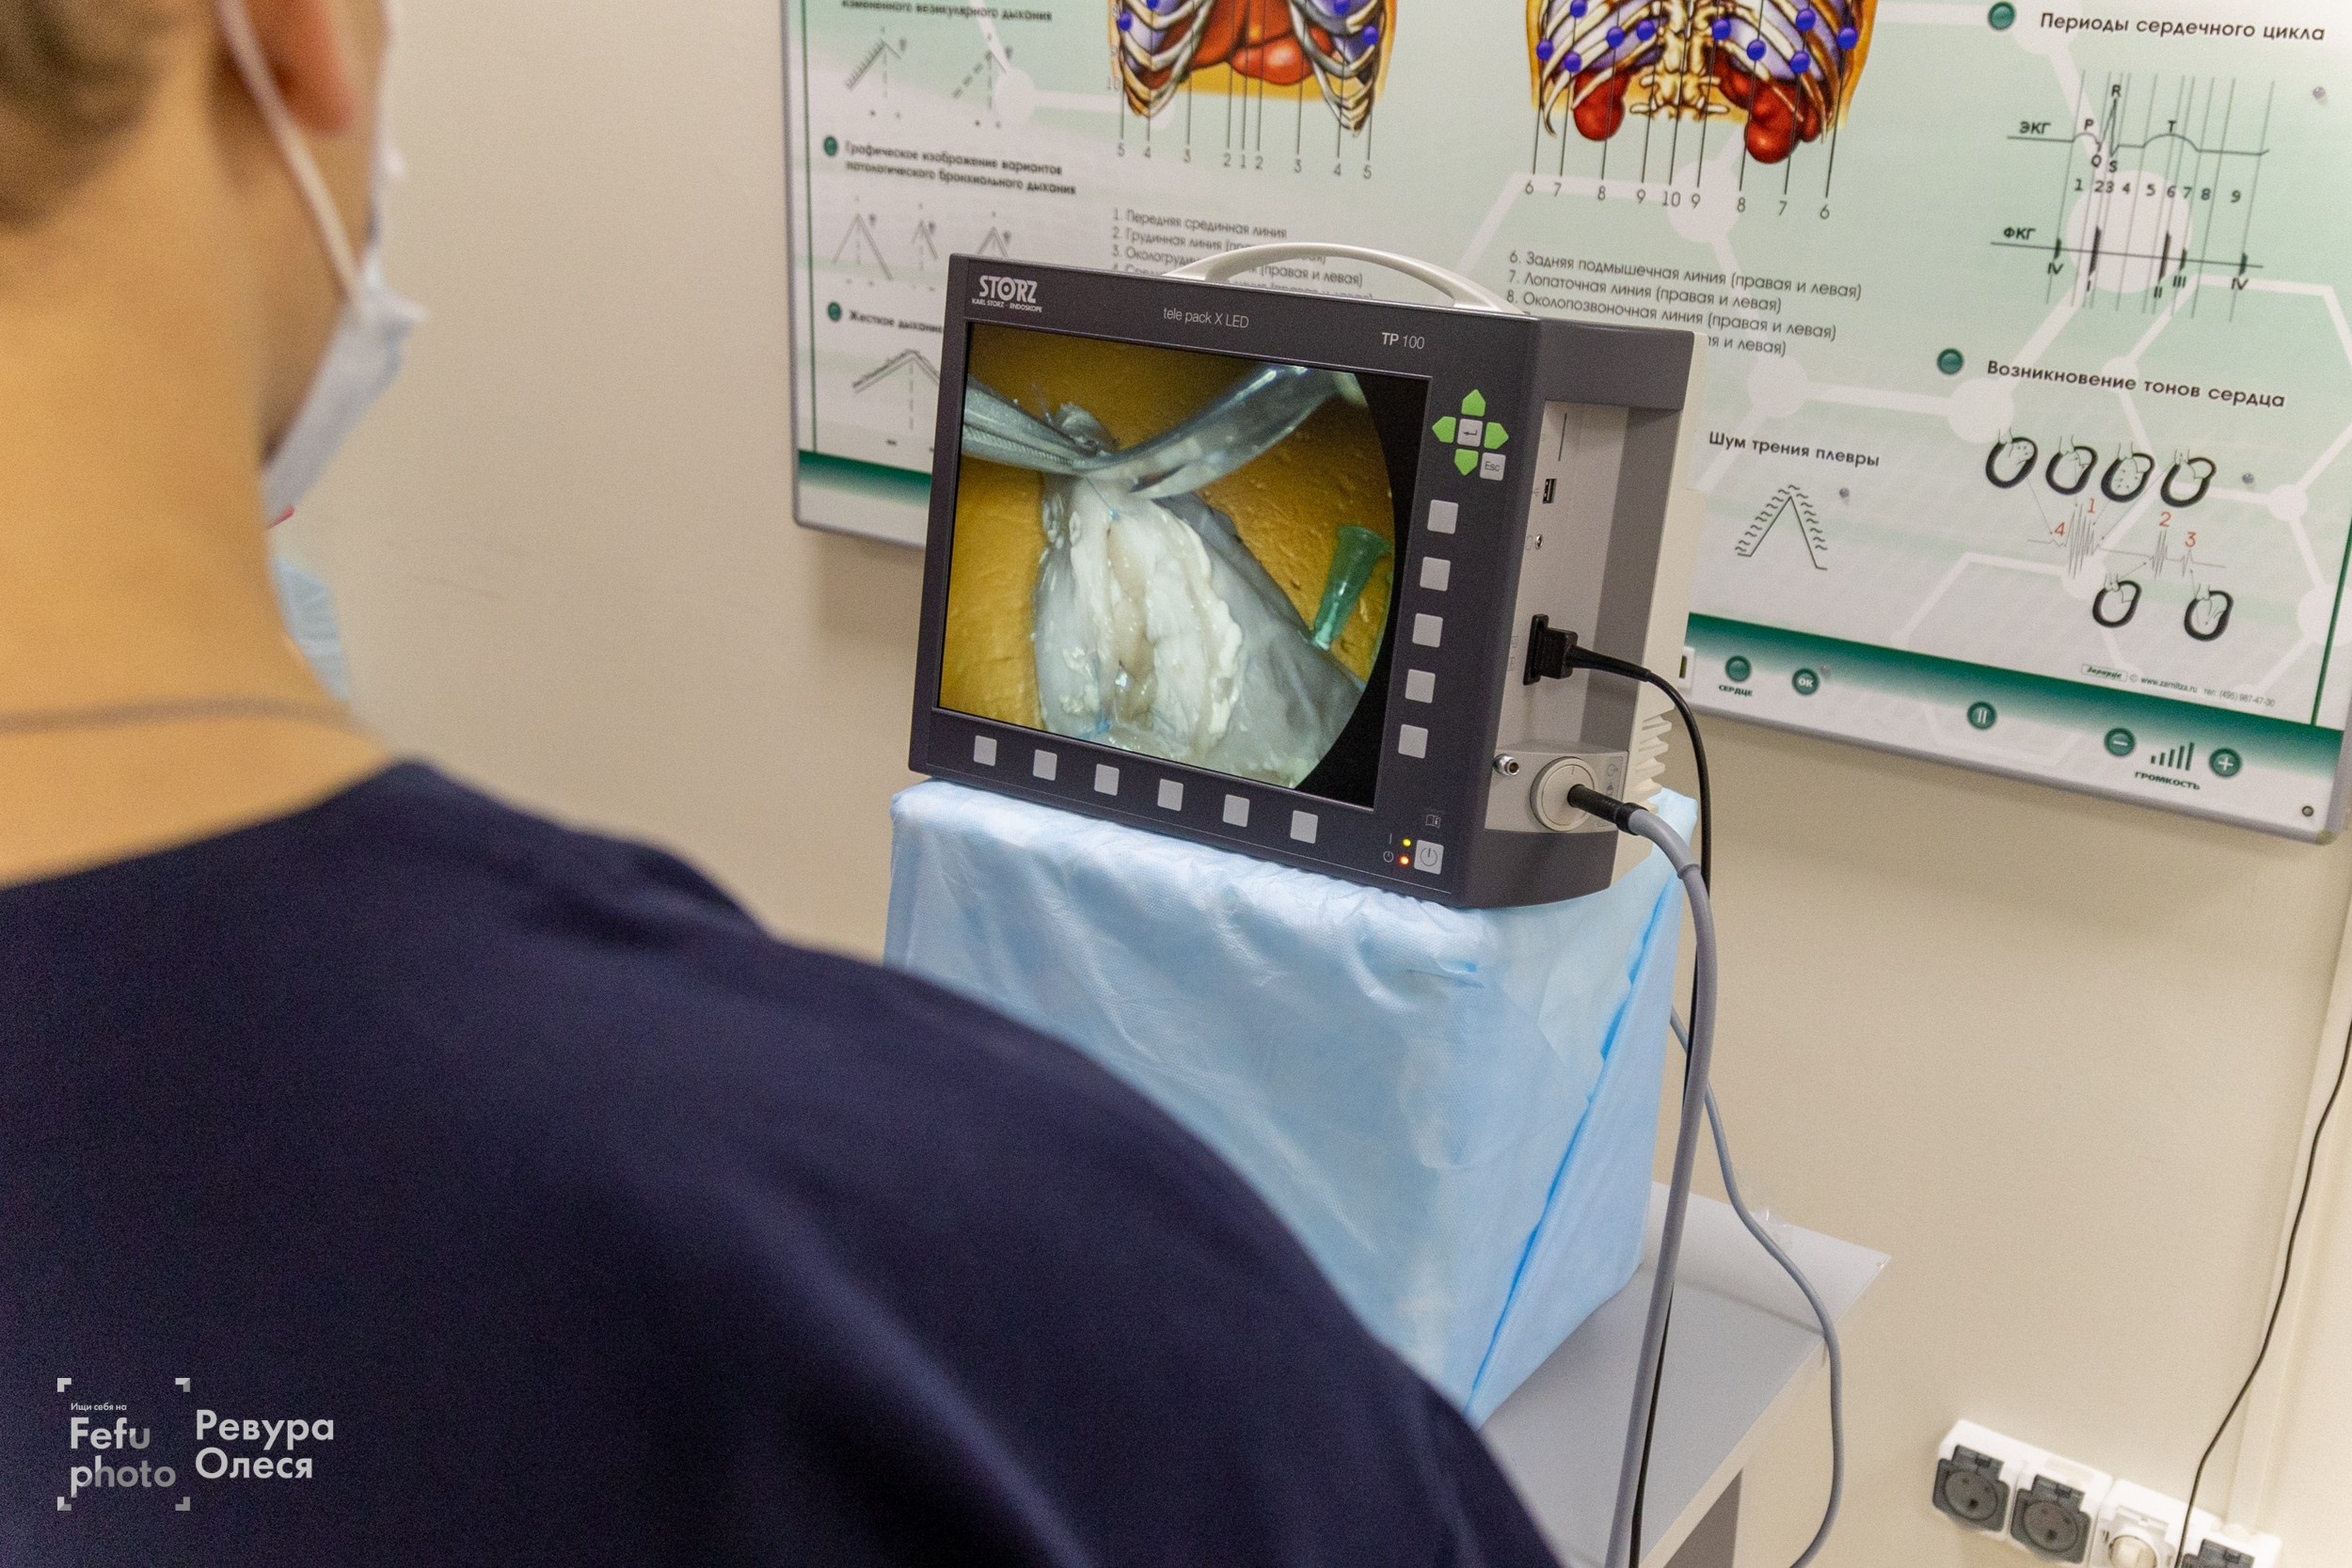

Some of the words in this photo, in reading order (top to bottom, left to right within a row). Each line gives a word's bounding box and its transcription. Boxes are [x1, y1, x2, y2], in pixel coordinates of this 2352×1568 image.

[2041, 12, 2129, 33] Периоды
[2136, 18, 2256, 38] сердечного
[2263, 24, 2325, 40] цикла
[2111, 85, 2122, 98] R
[2019, 120, 2051, 135] ЭКГ
[2084, 119, 2094, 132] P
[2168, 119, 2176, 135] T
[922, 150, 998, 169] изображение
[1223, 152, 1232, 167] 2
[1240, 154, 1248, 169] 1
[1255, 155, 1263, 170] 2
[1294, 159, 1303, 173] 3
[1332, 163, 1343, 177] 4
[1363, 165, 1373, 180] 5
[2108, 160, 2118, 173] S
[2074, 179, 2083, 193] 1
[2094, 181, 2104, 194] 2
[2106, 182, 2115, 195] 3
[2122, 182, 2132, 196] 4
[2146, 184, 2156, 198] 5
[2167, 186, 2176, 199] 6
[2183, 186, 2193, 200] 7
[2200, 188, 2211, 201] 8
[2231, 190, 2242, 204] 9
[1525, 182, 1534, 195] 6
[1553, 182, 1563, 197] 7
[1597, 185, 1606, 200] 8
[1636, 189, 1646, 204] 9
[1662, 191, 1681, 207] 10
[1691, 193, 1701, 209] 9
[1737, 197, 1746, 213] 8
[1779, 200, 1788, 216] 7
[1820, 204, 1831, 220] 6
[1127, 208, 1183, 229] Передняя
[1185, 217, 1250, 235] срединная
[1252, 225, 1288, 239] линия
[1126, 227, 1187, 246] Грудинная
[1189, 237, 1222, 251] линия
[2003, 227, 2036, 241] ФКГ
[1509, 250, 1521, 264] 6.
[1526, 251, 1575, 270] Задняя
[1579, 258, 1679, 280] подмышечная
[1683, 269, 1726, 286] линия
[1731, 271, 1792, 292] (правая
[1796, 281, 1806, 293] и
[1810, 282, 1862, 302] левая)
[2047, 261, 2065, 276] IV
[1311, 271, 1320, 280] и
[1324, 272, 1363, 289] левая)
[2231, 277, 2249, 291] IV
[979, 275, 1038, 304] STORZ
[1508, 269, 1519, 284] 7.
[1524, 272, 1607, 293] Лопаточная
[1611, 283, 1652, 298] линия
[1656, 285, 1715, 305] (правая
[1719, 295, 1728, 307] и
[1732, 296, 1782, 315] левая)
[972, 297, 986, 307] KARL
[987, 299, 1005, 309] STORZ
[1009, 302, 1042, 313] ENDOSKOPE
[1163, 308, 1183, 322] tele
[1185, 311, 1212, 325] pack
[1214, 312, 1224, 325] X
[1225, 314, 1250, 328] LED
[1506, 289, 1518, 304] 8.
[1523, 291, 1657, 320] Околопозвоночная
[1661, 309, 1703, 325] линия
[1708, 312, 1768, 331] (правая
[1772, 322, 1782, 333] и
[1786, 323, 1836, 342] левая)
[1381, 332, 1399, 346] TP
[1403, 335, 1425, 350] 100
[1724, 338, 1733, 348] и
[1738, 339, 1787, 358] левая)
[1987, 360, 2137, 391] Возникновение
[2144, 380, 2201, 398] тонов
[2208, 388, 2285, 408] сердца
[1708, 431, 1746, 451] Шум
[1752, 438, 1810, 458] трения
[1816, 448, 1880, 468] плевры
[1484, 460, 1501, 472] Esc
[2087, 497, 2096, 515] 1
[2158, 511, 2171, 528] 2
[2054, 521, 2066, 537] 4
[2185, 531, 2197, 548] 3
[2135, 770, 2201, 791] ГРОМКОСТЬ
